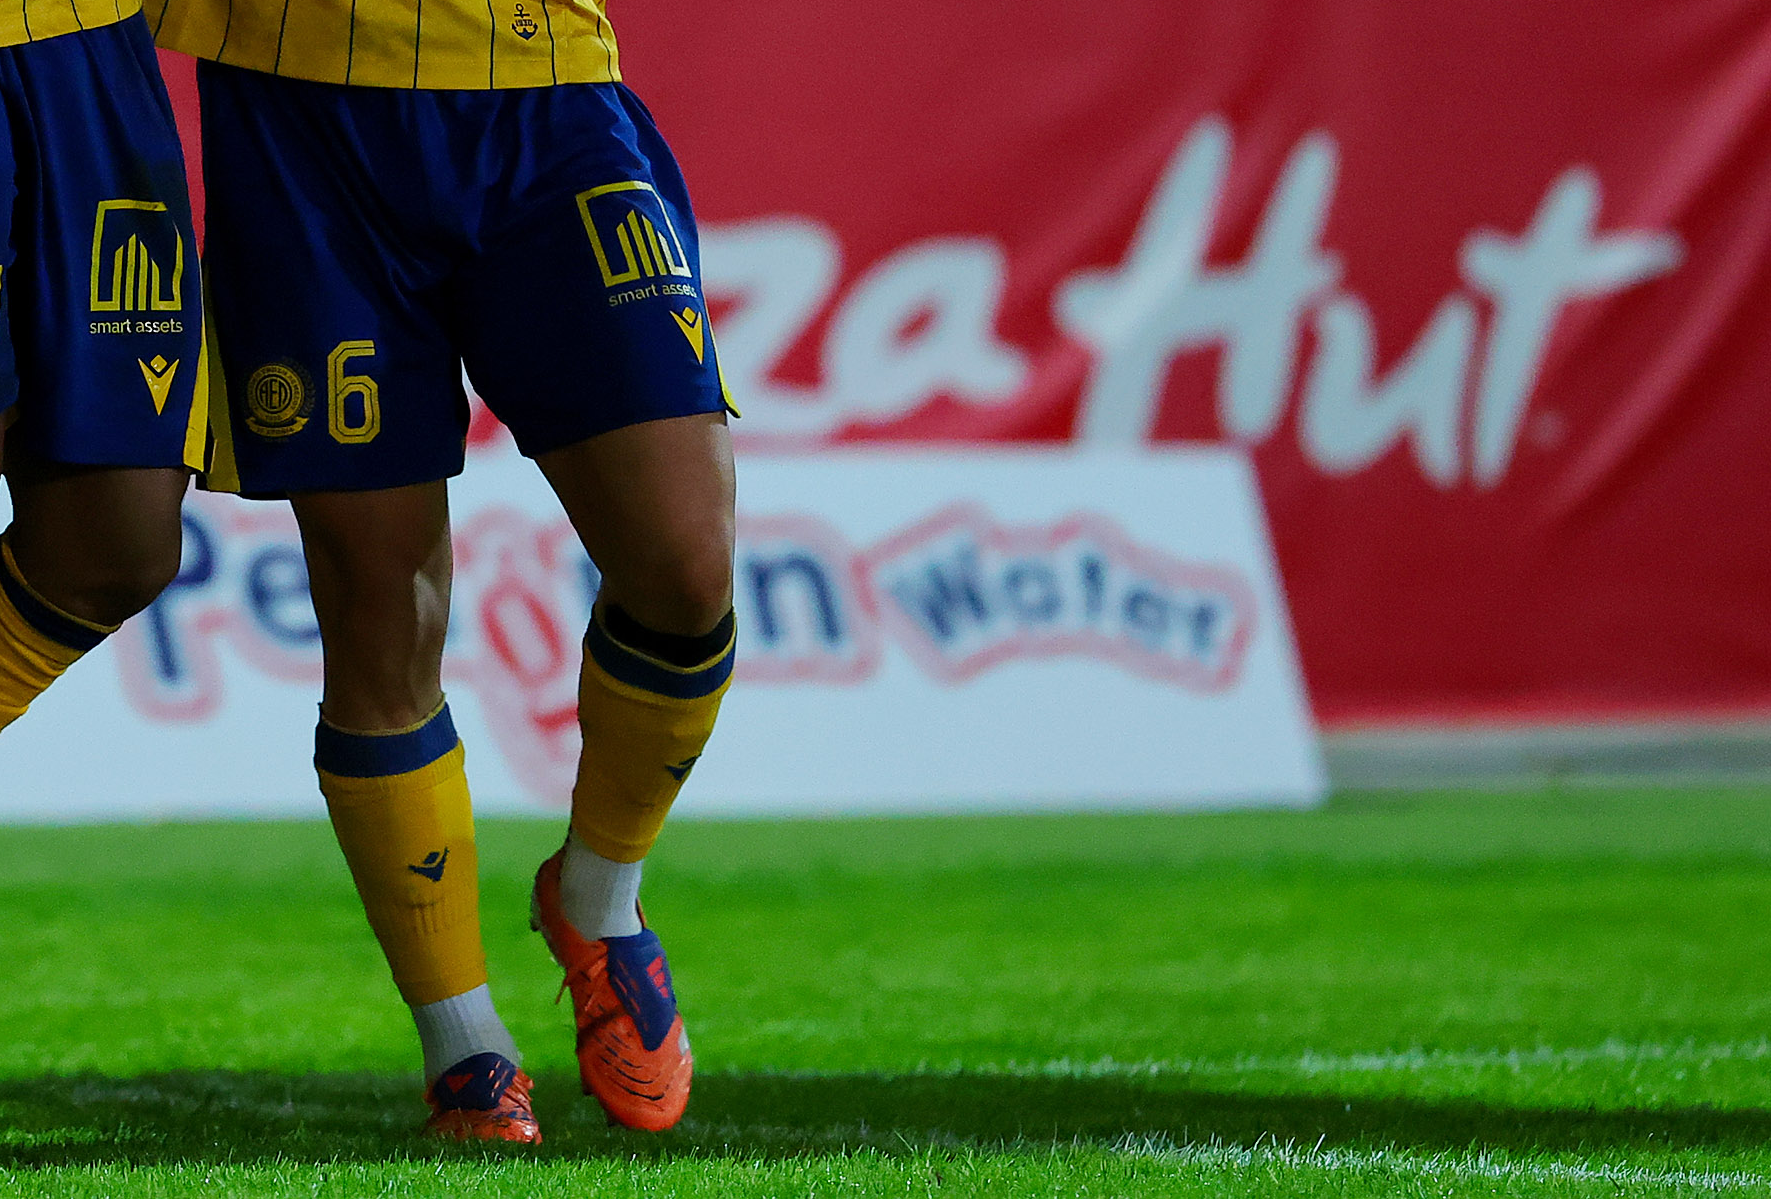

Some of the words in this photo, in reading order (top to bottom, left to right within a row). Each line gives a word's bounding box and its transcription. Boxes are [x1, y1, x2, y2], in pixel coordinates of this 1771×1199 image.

[89, 318, 132, 334] smart
[135, 317, 183, 334] assets
[608, 283, 659, 307] smart
[1052, 117, 1687, 491] Hut
[326, 339, 381, 445] 6
